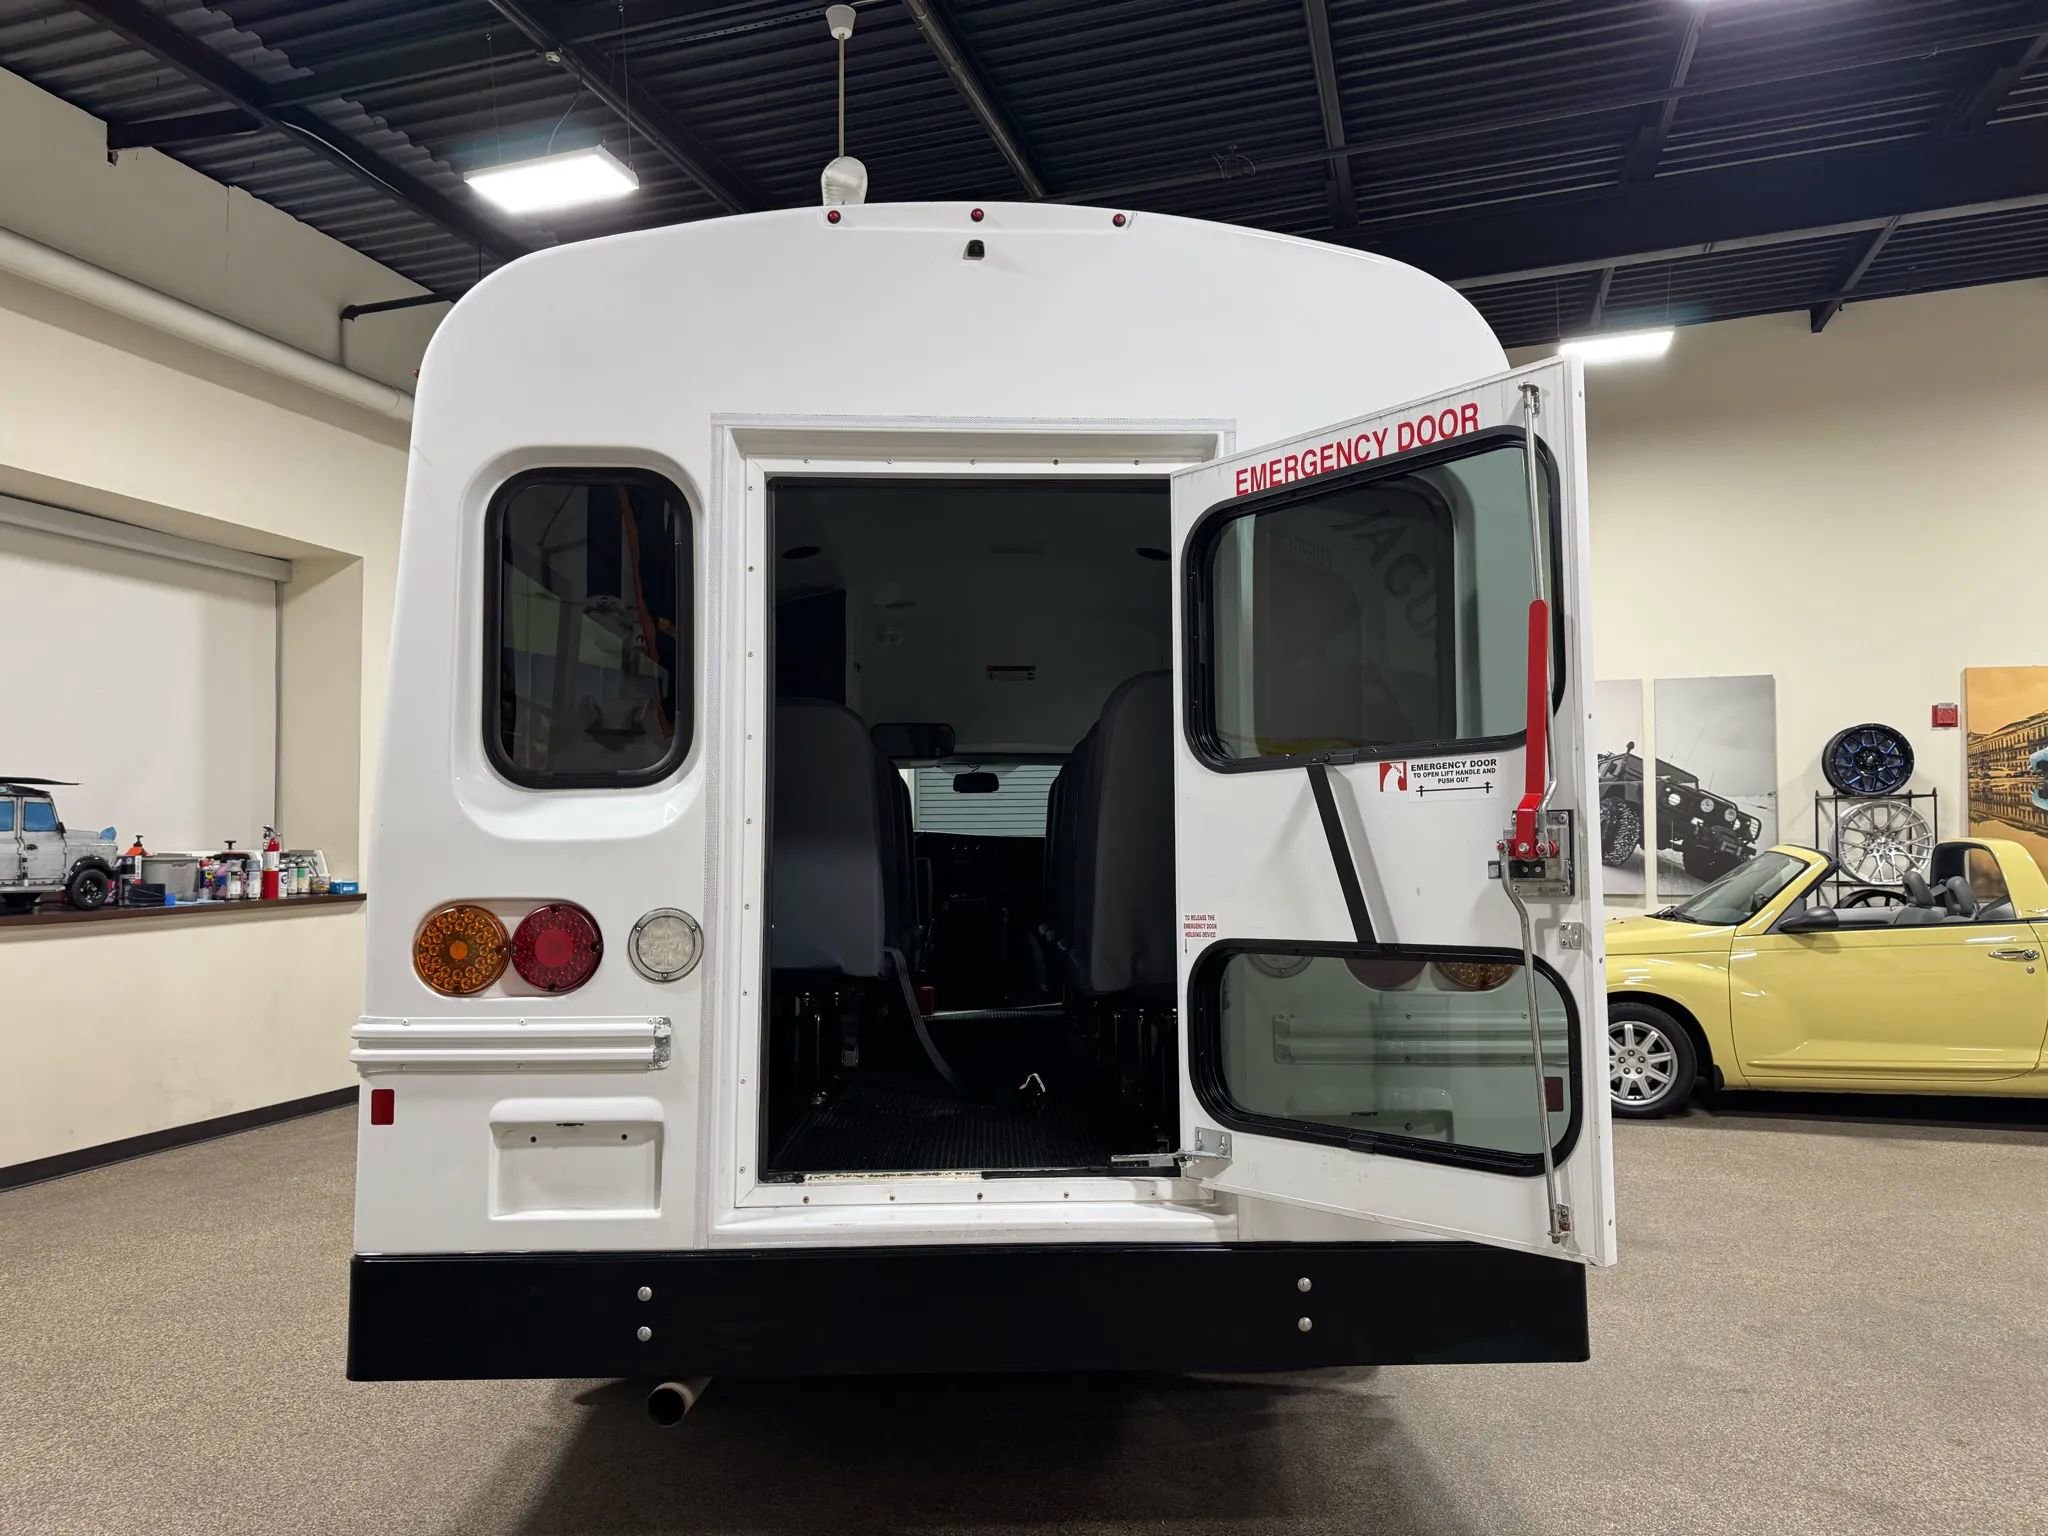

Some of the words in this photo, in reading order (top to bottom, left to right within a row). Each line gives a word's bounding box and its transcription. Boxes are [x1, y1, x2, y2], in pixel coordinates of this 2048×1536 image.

[1235, 427, 1390, 497] EMERGENCY
[1397, 402, 1480, 453] DOOR
[1411, 761, 1466, 772] EMERGENCY
[1470, 758, 1497, 768] DOOR
[1455, 768, 1480, 776] HANDLE
[1482, 767, 1496, 775] AND
